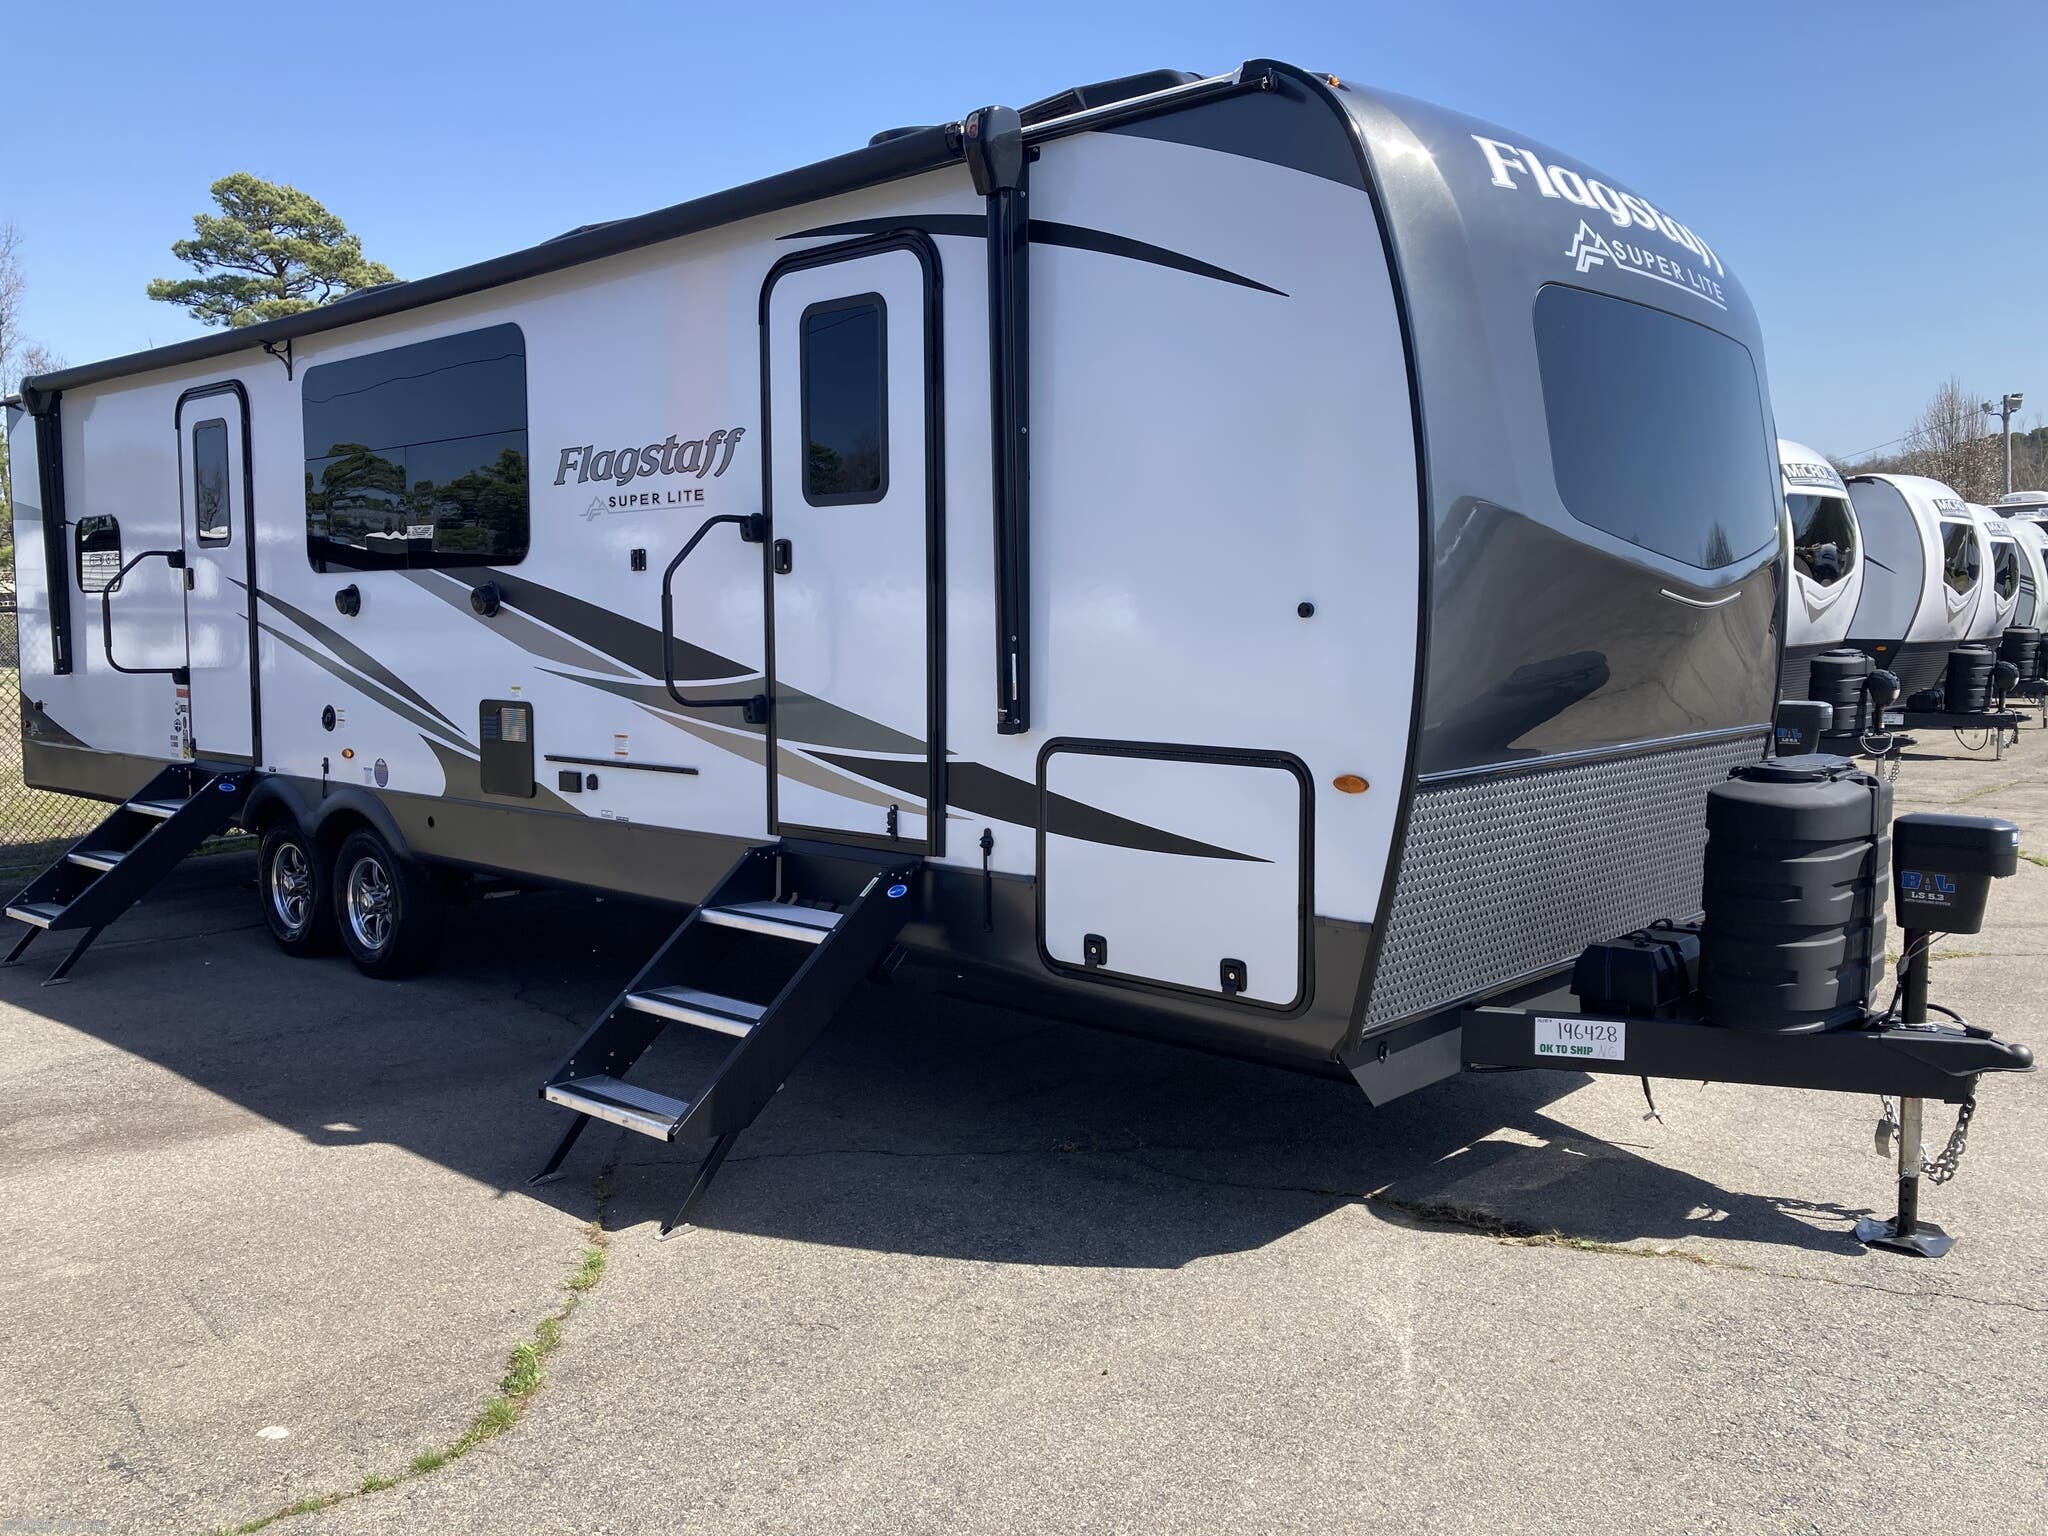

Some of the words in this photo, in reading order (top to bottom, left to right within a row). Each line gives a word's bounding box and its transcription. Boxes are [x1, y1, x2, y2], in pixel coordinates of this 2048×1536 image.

[1612, 239, 1685, 282] SUPER
[1688, 268, 1725, 302] LITE
[554, 427, 746, 486] Flagstaff
[608, 493, 660, 508] SUPER
[668, 489, 705, 503] LITE
[1901, 870, 1956, 893] BAL
[1911, 891, 1926, 899] LS
[1928, 893, 1945, 901] 5.3
[1558, 1022, 1618, 1042] 196428
[1540, 1043, 1553, 1053] OK
[1556, 1045, 1568, 1054] TO
[1570, 1045, 1593, 1056] SHIP
